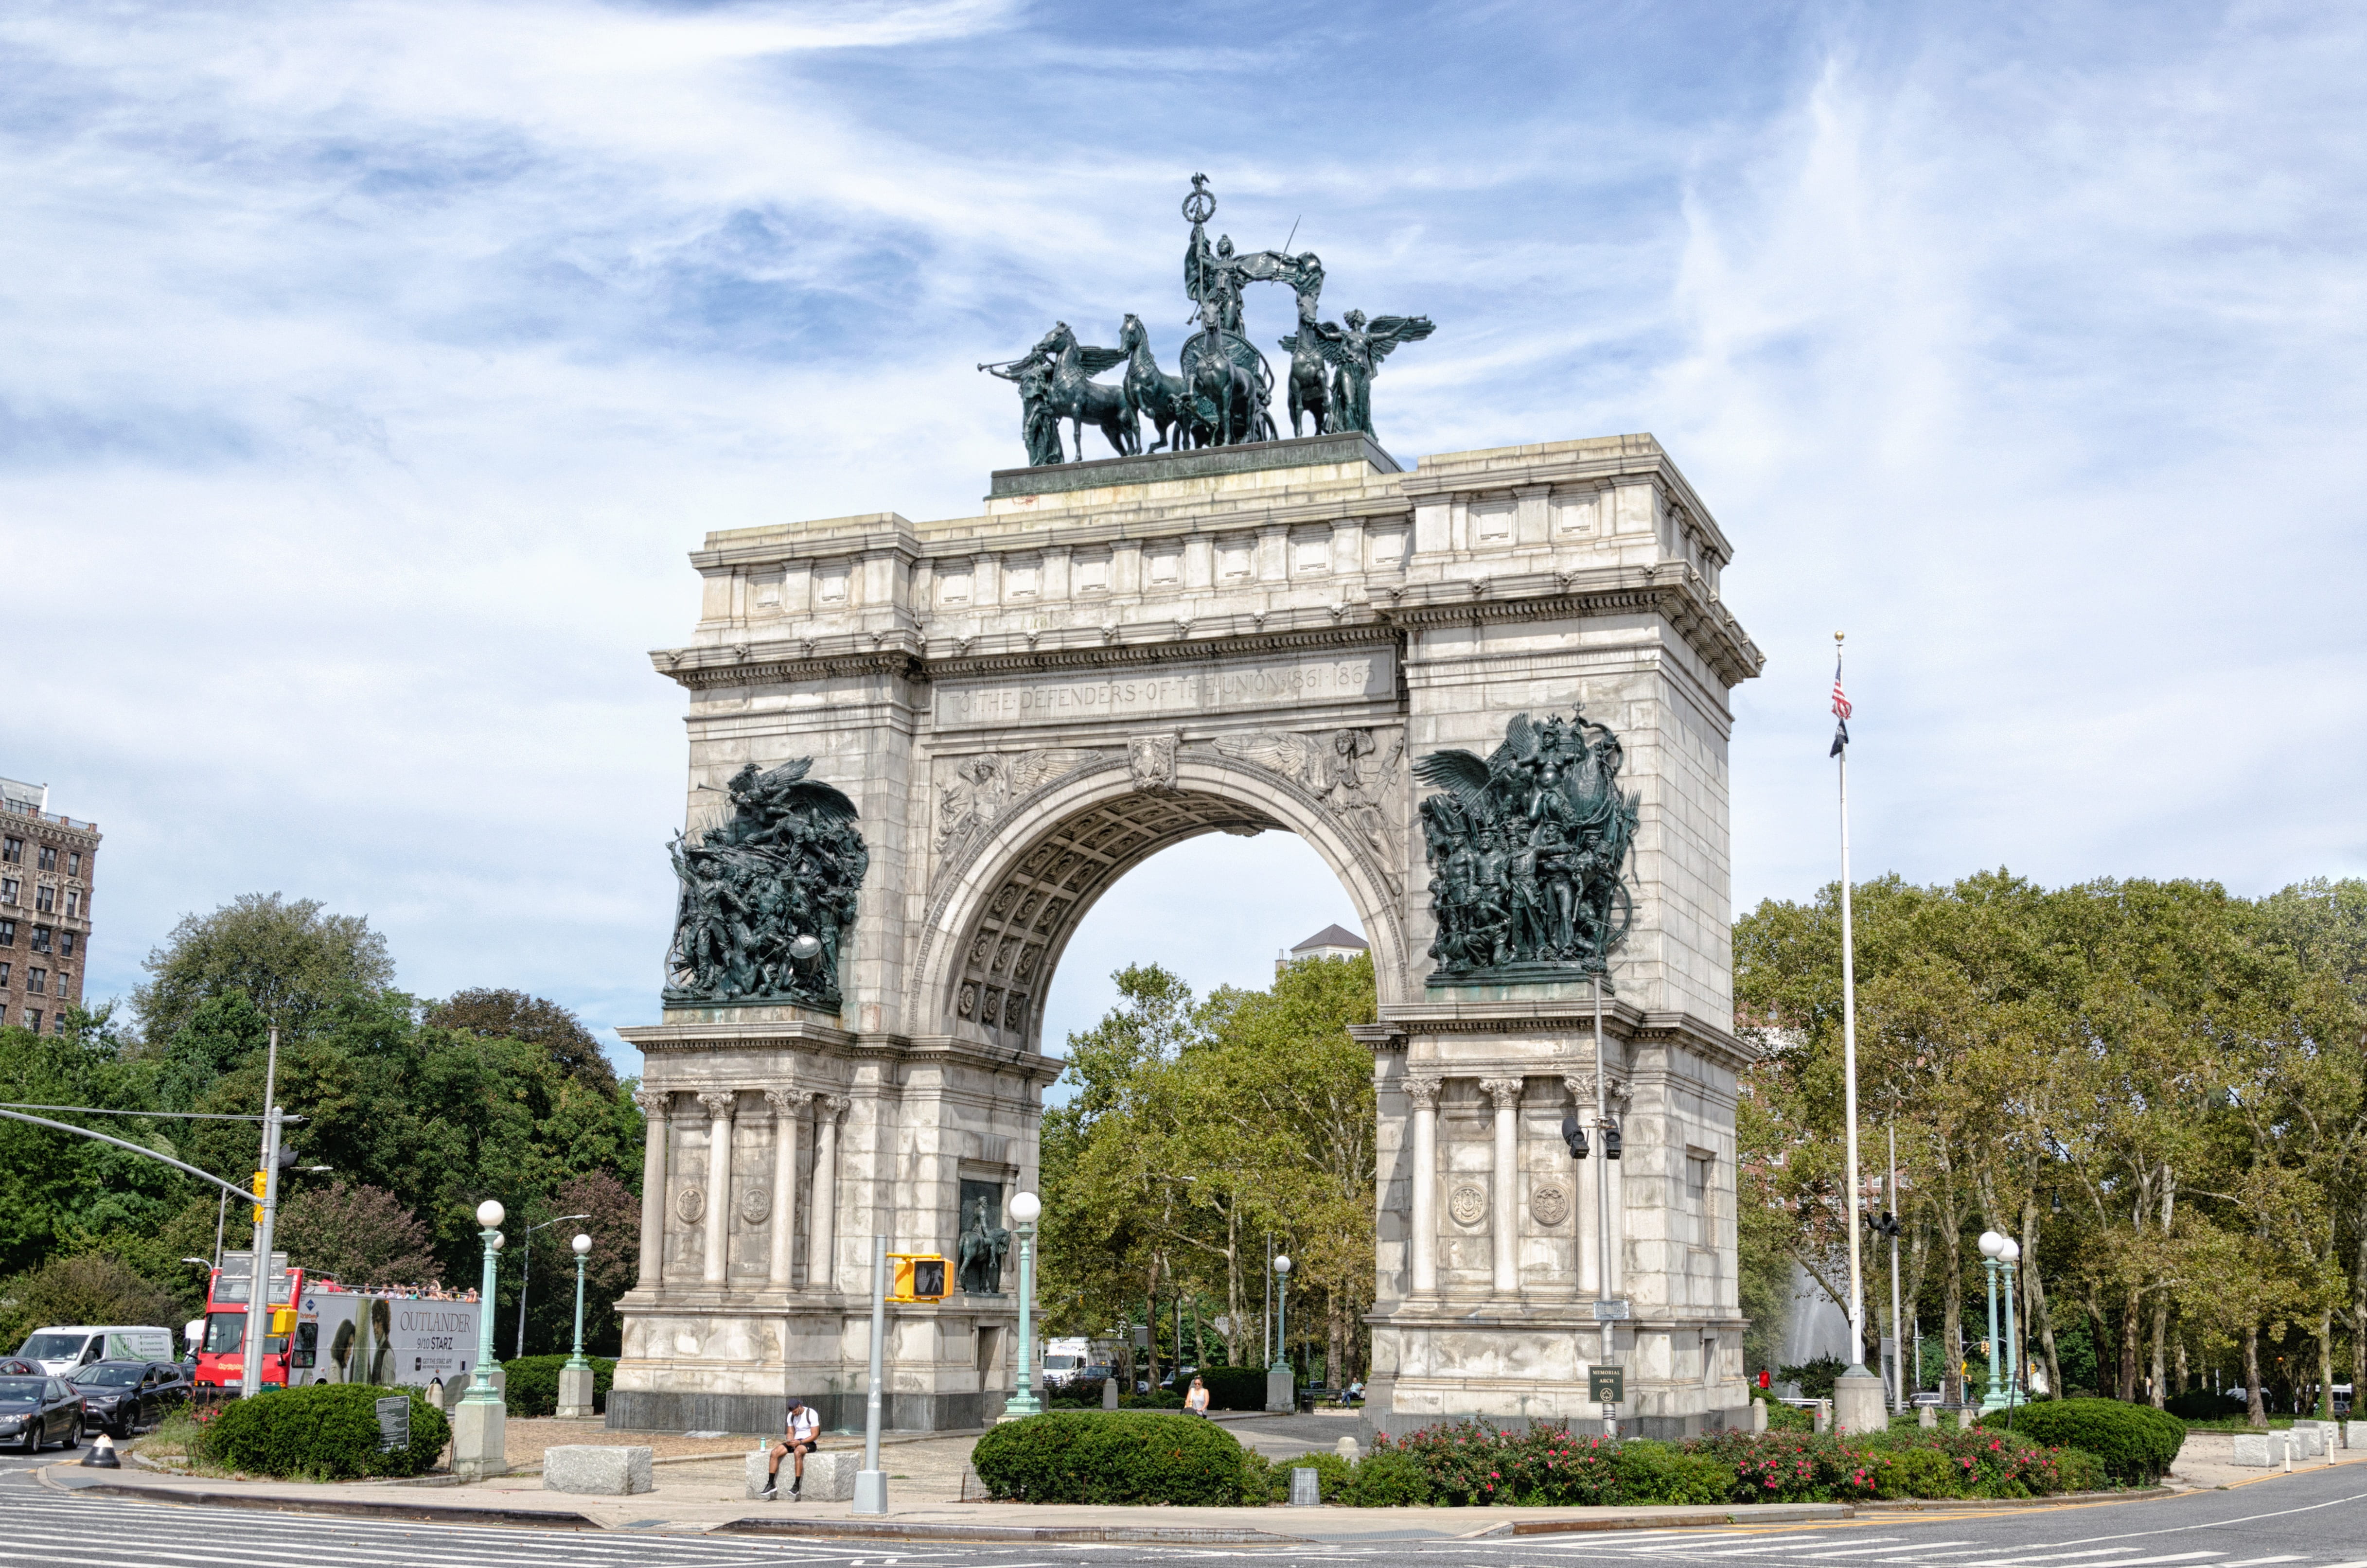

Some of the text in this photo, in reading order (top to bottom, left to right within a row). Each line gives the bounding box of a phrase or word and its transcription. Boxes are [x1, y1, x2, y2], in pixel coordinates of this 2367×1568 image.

[949, 664, 1375, 713] TO THE DEFENDERS OF THE UNION 1861 1865
[400, 1311, 471, 1334] OUTLANDER
[417, 1337, 453, 1350] 9/10 STARZ
